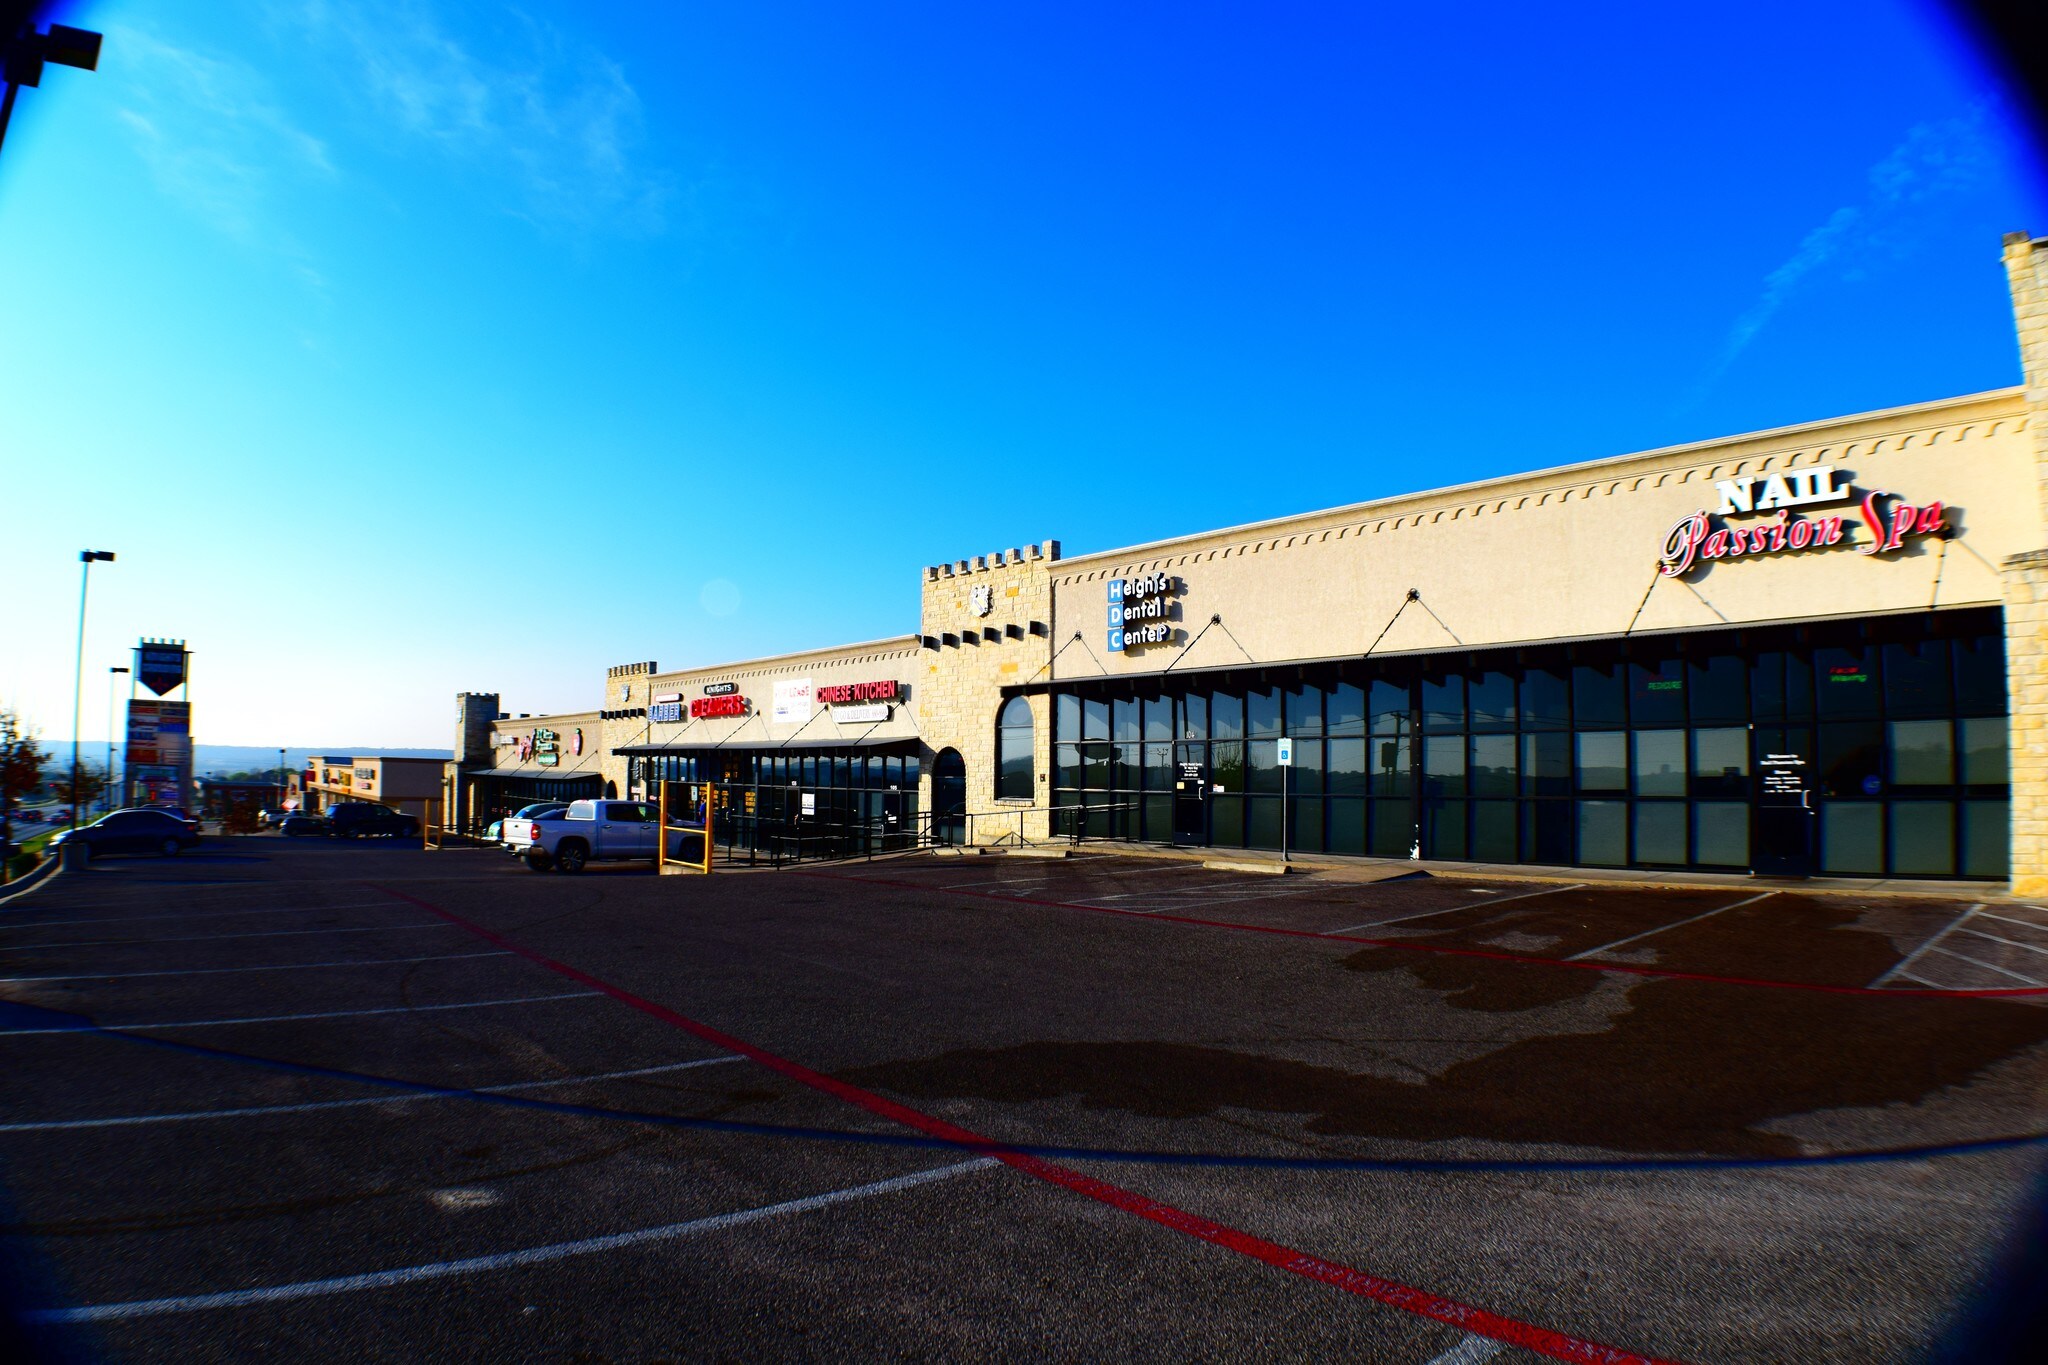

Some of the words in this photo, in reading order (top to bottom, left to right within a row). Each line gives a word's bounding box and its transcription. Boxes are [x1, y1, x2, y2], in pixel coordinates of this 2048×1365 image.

[1714, 465, 1849, 515] NAIL
[1660, 509, 1843, 577] Passion
[1857, 490, 1945, 555] Spa
[1110, 572, 1167, 599] Heights
[1110, 596, 1161, 623] Dental
[706, 684, 732, 694] KNIGHTS
[816, 684, 851, 702] CHINESE
[853, 680, 895, 700] KITCHEN
[1648, 680, 1683, 691] PEDICURE
[648, 703, 681, 722] BARBER
[690, 695, 745, 718] CLEANERS
